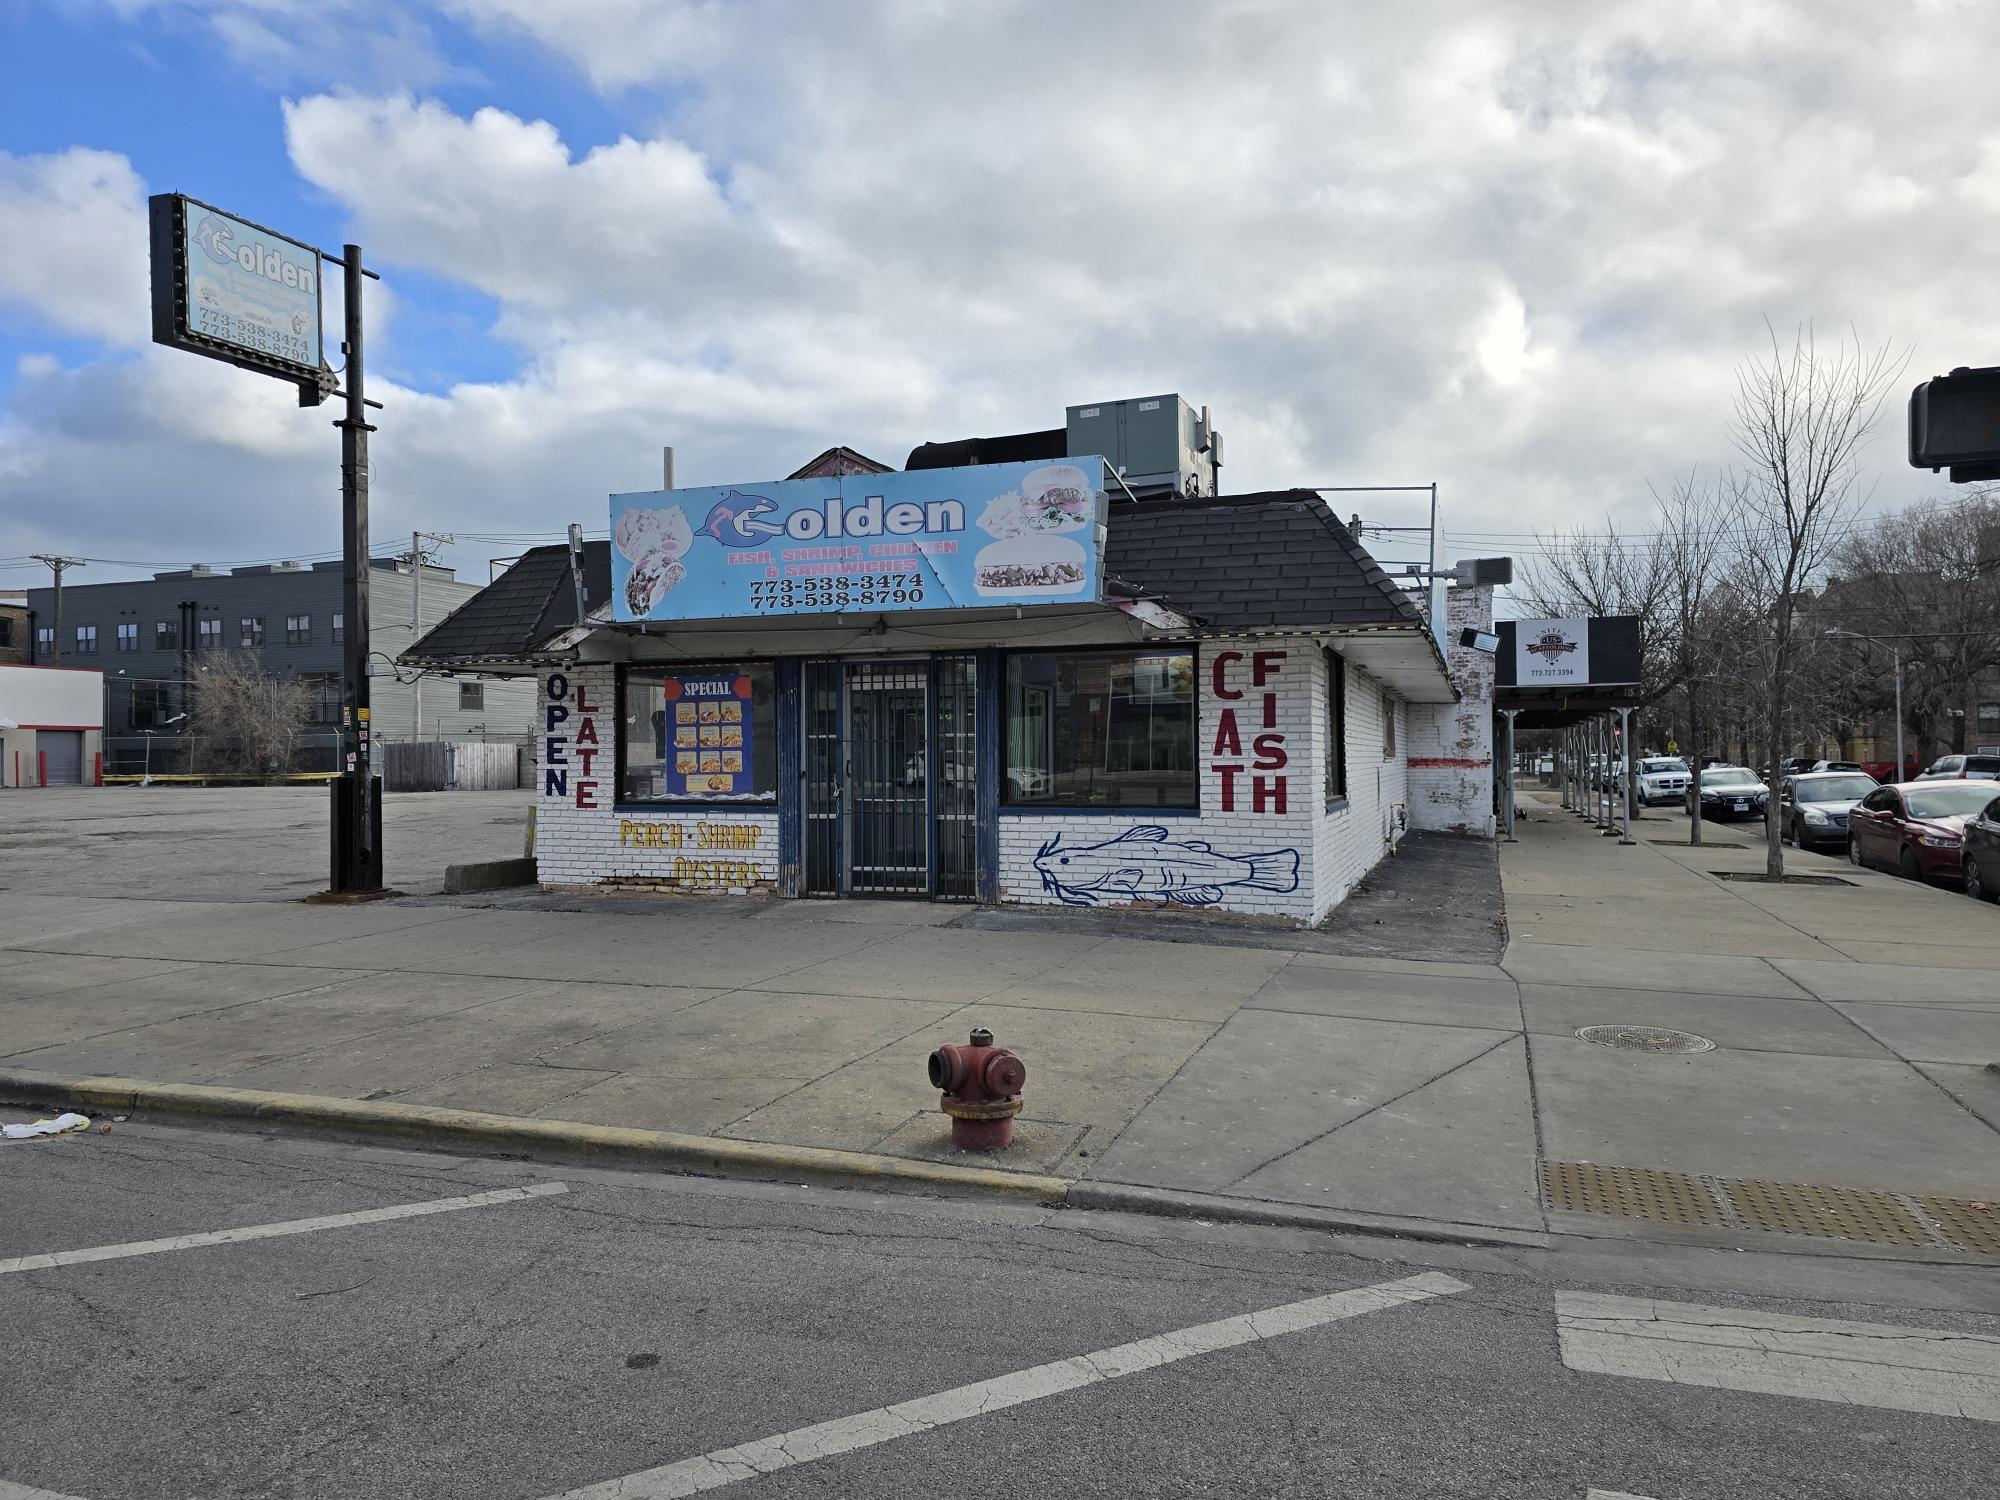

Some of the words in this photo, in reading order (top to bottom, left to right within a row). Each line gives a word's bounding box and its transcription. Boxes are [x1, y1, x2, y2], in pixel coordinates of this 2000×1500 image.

[194, 216, 315, 295] Golden
[199, 307, 310, 351] 773-538-3474
[199, 320, 310, 363] 773-538-8790
[697, 490, 966, 548] Golden
[727, 551, 776, 566] FISH,
[782, 545, 864, 561] SHRIMP,
[765, 566, 780, 578] &
[785, 559, 918, 576] SANDWICHES
[750, 573, 924, 595] 773-538-3474
[750, 588, 924, 609] 773-538-8790
[684, 681, 732, 696] SPECIAL
[1531, 669, 1574, 677] 773.727.3394
[546, 673, 569, 797] OPEN
[576, 685, 599, 809] LATE
[1211, 651, 1244, 812] CAT
[1252, 651, 1287, 814] FISH
[619, 819, 683, 849] PERCH
[695, 821, 762, 850] SHRIMP
[673, 856, 763, 889] OYSTERS
